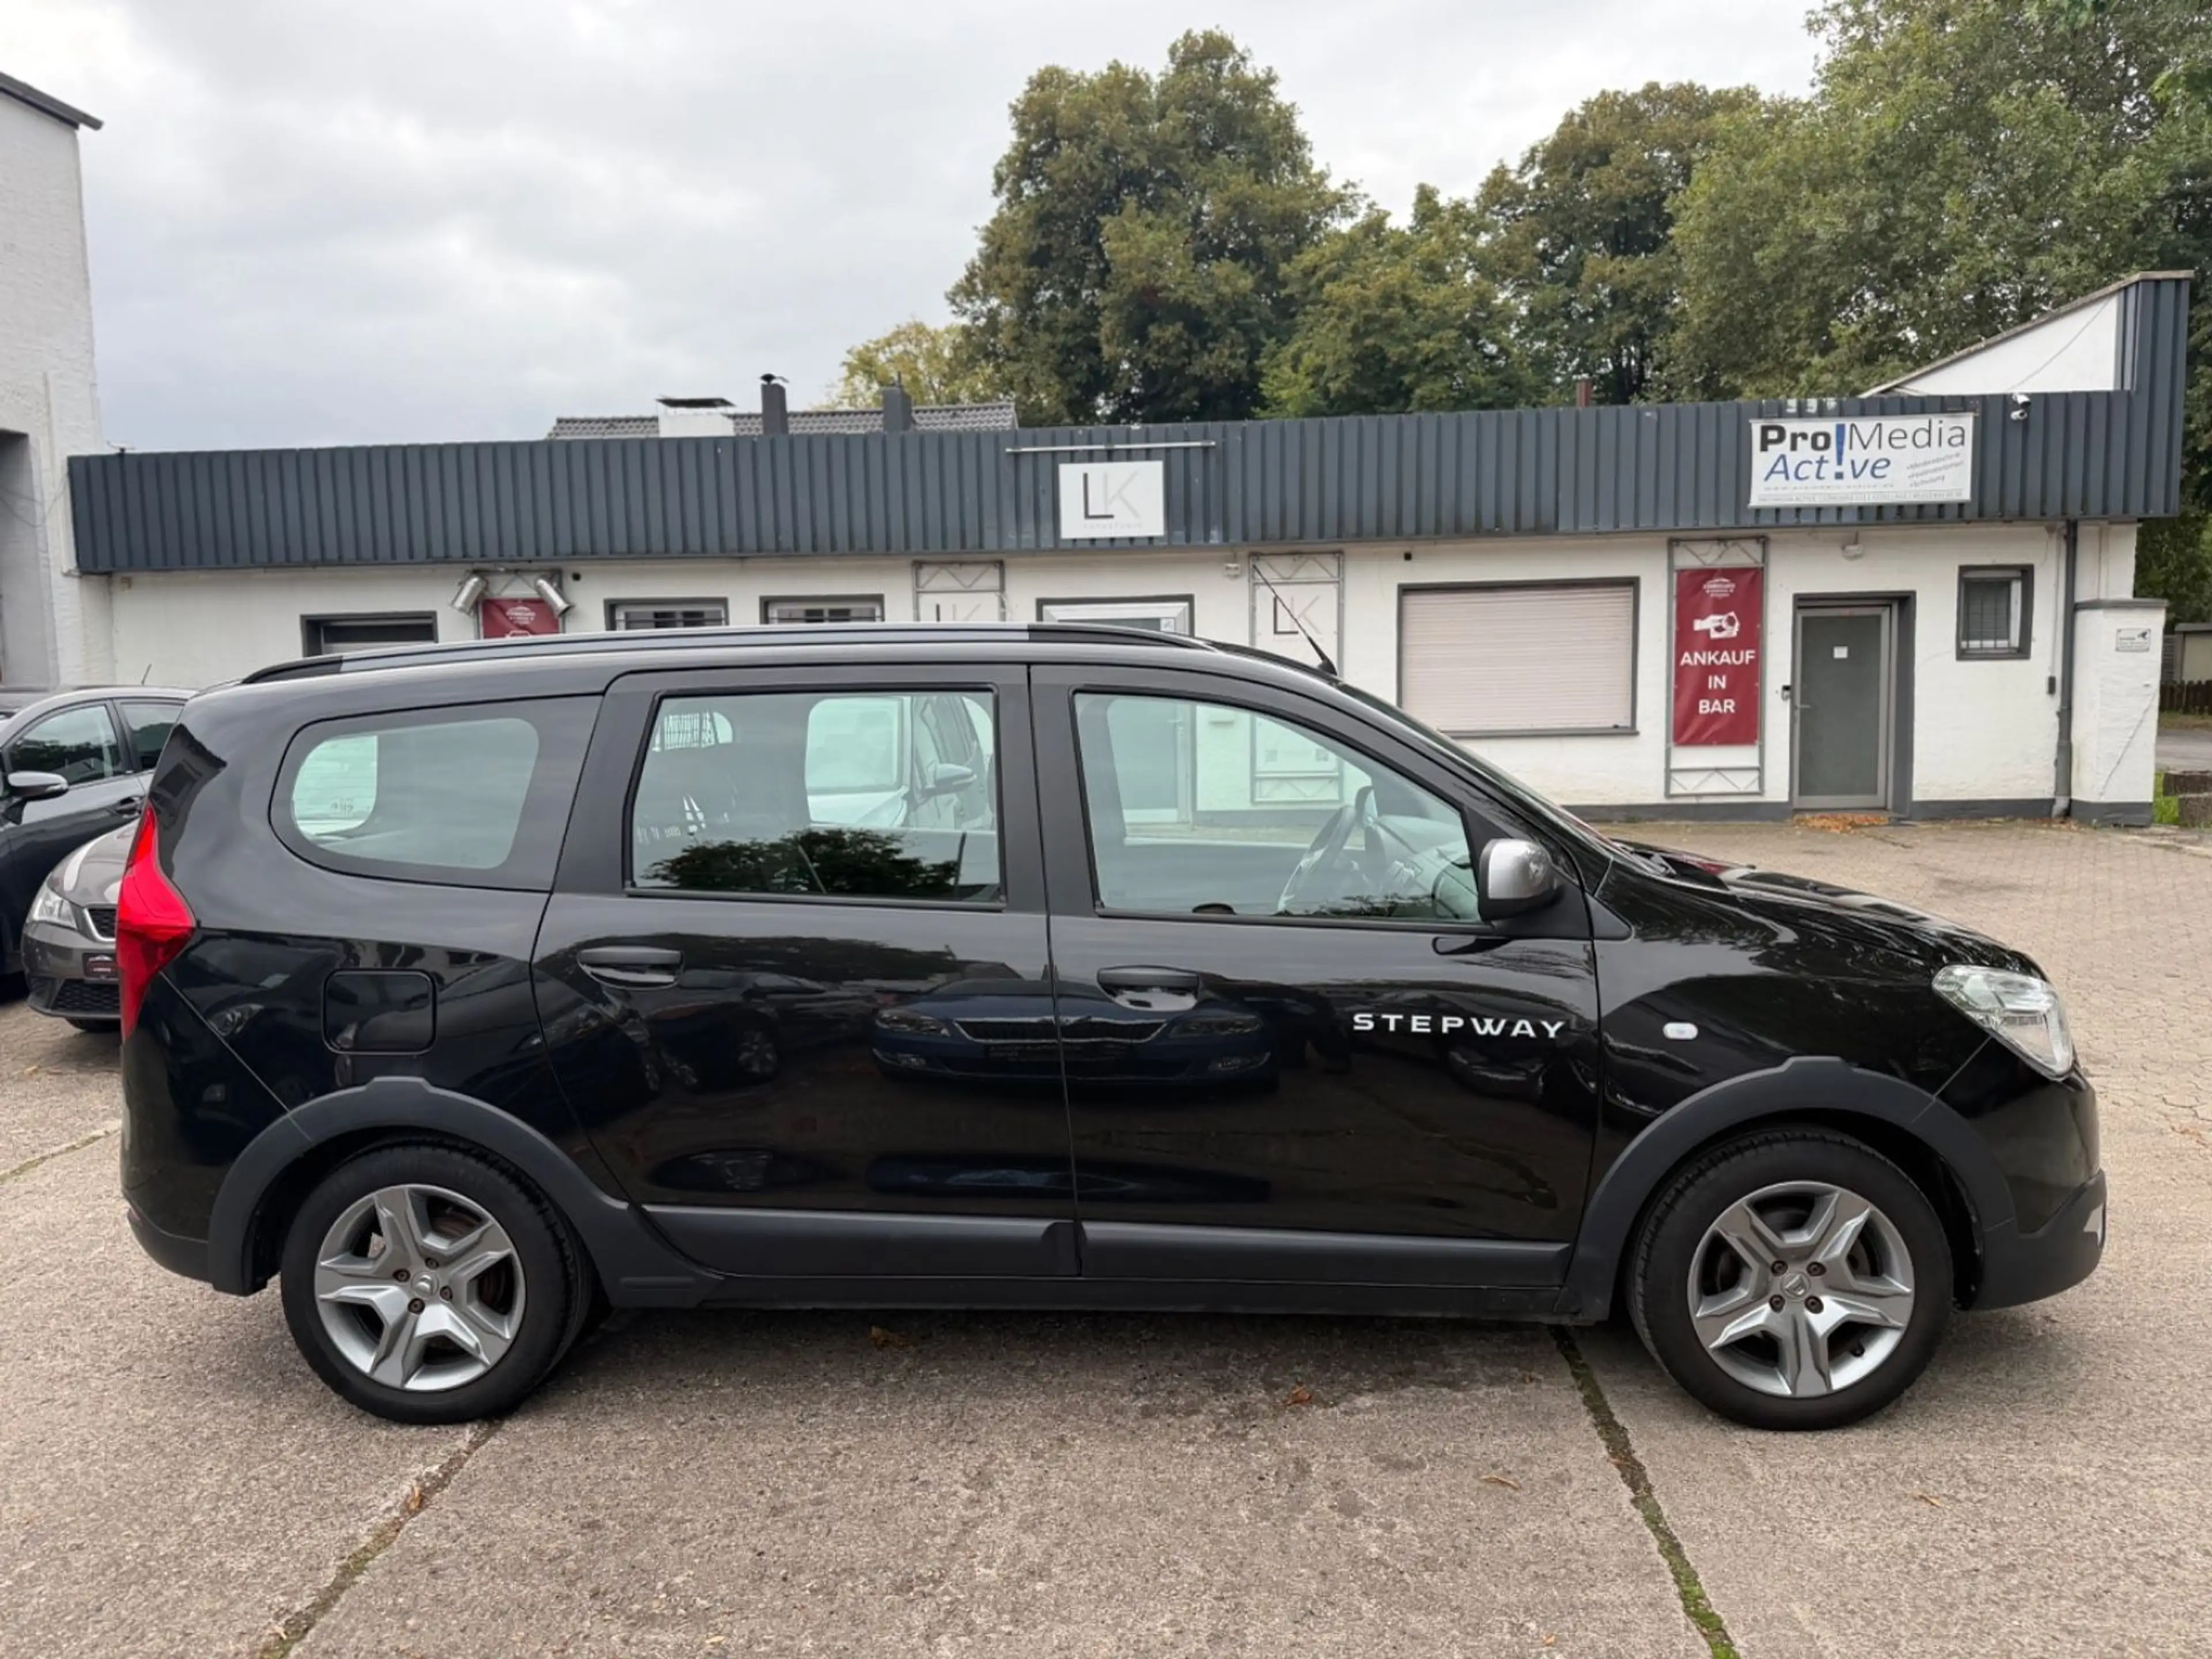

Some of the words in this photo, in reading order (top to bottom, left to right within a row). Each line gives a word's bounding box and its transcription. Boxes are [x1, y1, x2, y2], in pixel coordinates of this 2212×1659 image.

[1083, 471, 1141, 520] LK
[1680, 650, 1756, 666] ANKAUF
[1708, 675, 1727, 690] IN
[1698, 699, 1736, 714] BAR
[1353, 1013, 1566, 1039] STEPWAY
